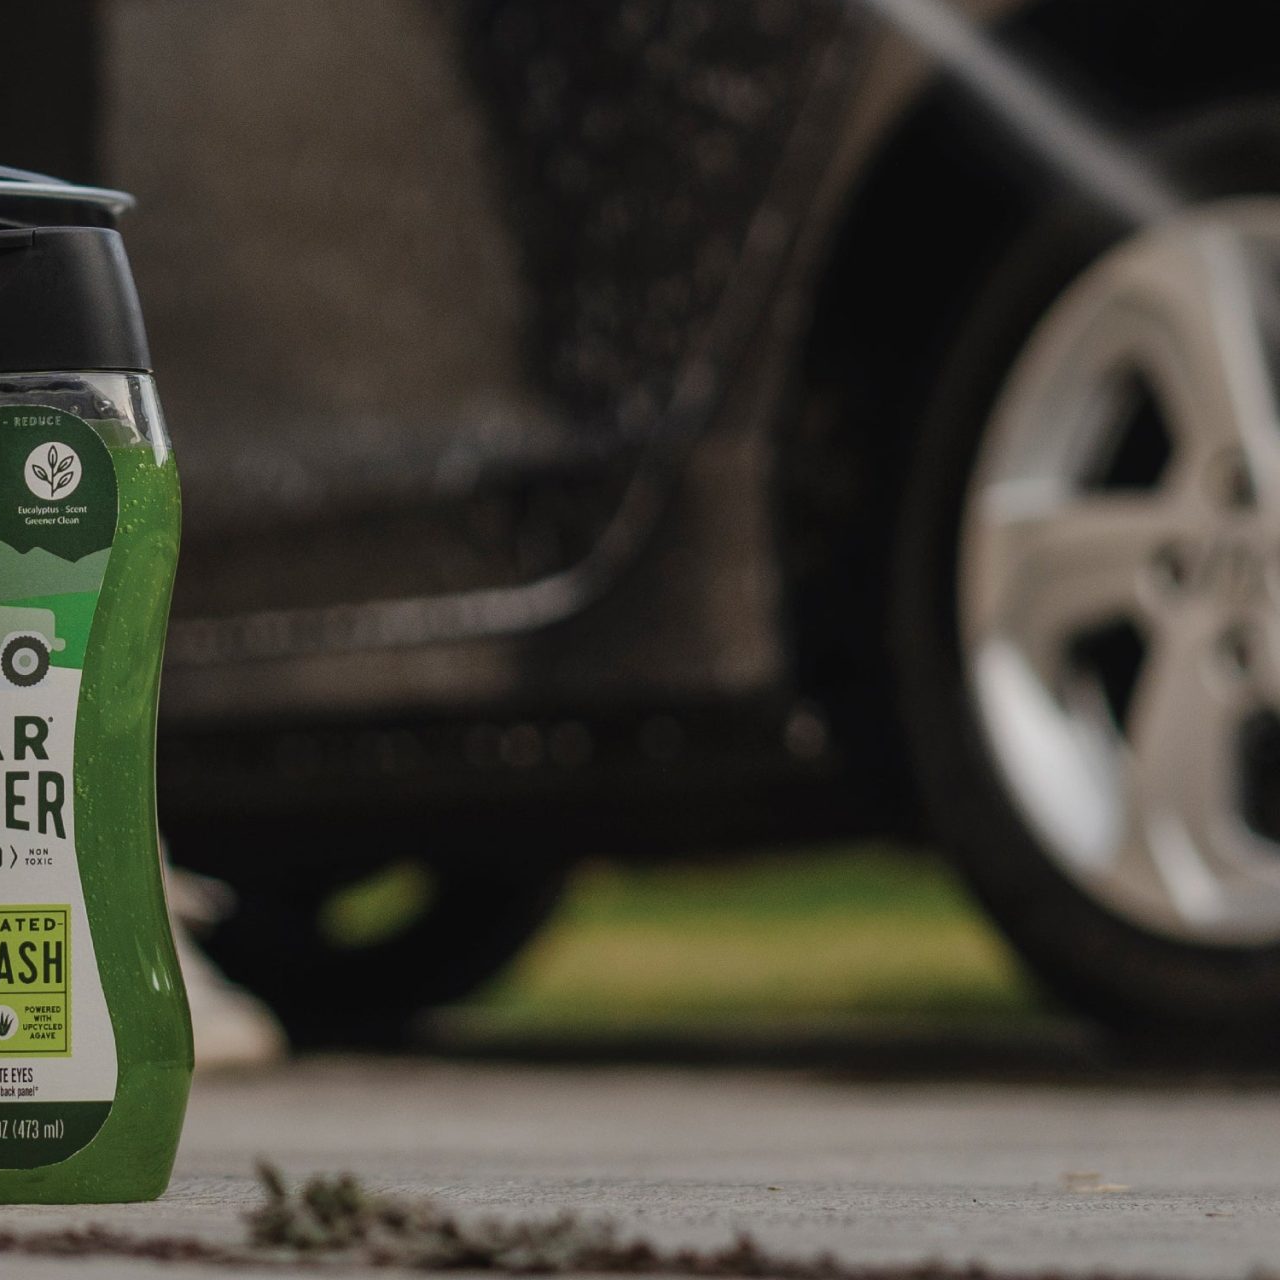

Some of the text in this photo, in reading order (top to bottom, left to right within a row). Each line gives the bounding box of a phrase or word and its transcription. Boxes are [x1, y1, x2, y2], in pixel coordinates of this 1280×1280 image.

[14, 416, 62, 427] REDUCE
[18, 505, 87, 515] Eucalyptus Scent
[25, 516, 80, 525] Greener Clean
[24, 1006, 61, 1014] POWERED
[33, 1014, 52, 1022] WITH
[22, 1023, 63, 1031] UPCYCLED
[29, 1031, 56, 1040] AGAVE
[11, 1067, 33, 1083] EYES
[0, 1085, 16, 1097] back
[12, 1119, 39, 1139] (473
[43, 1119, 64, 1139] ml)
